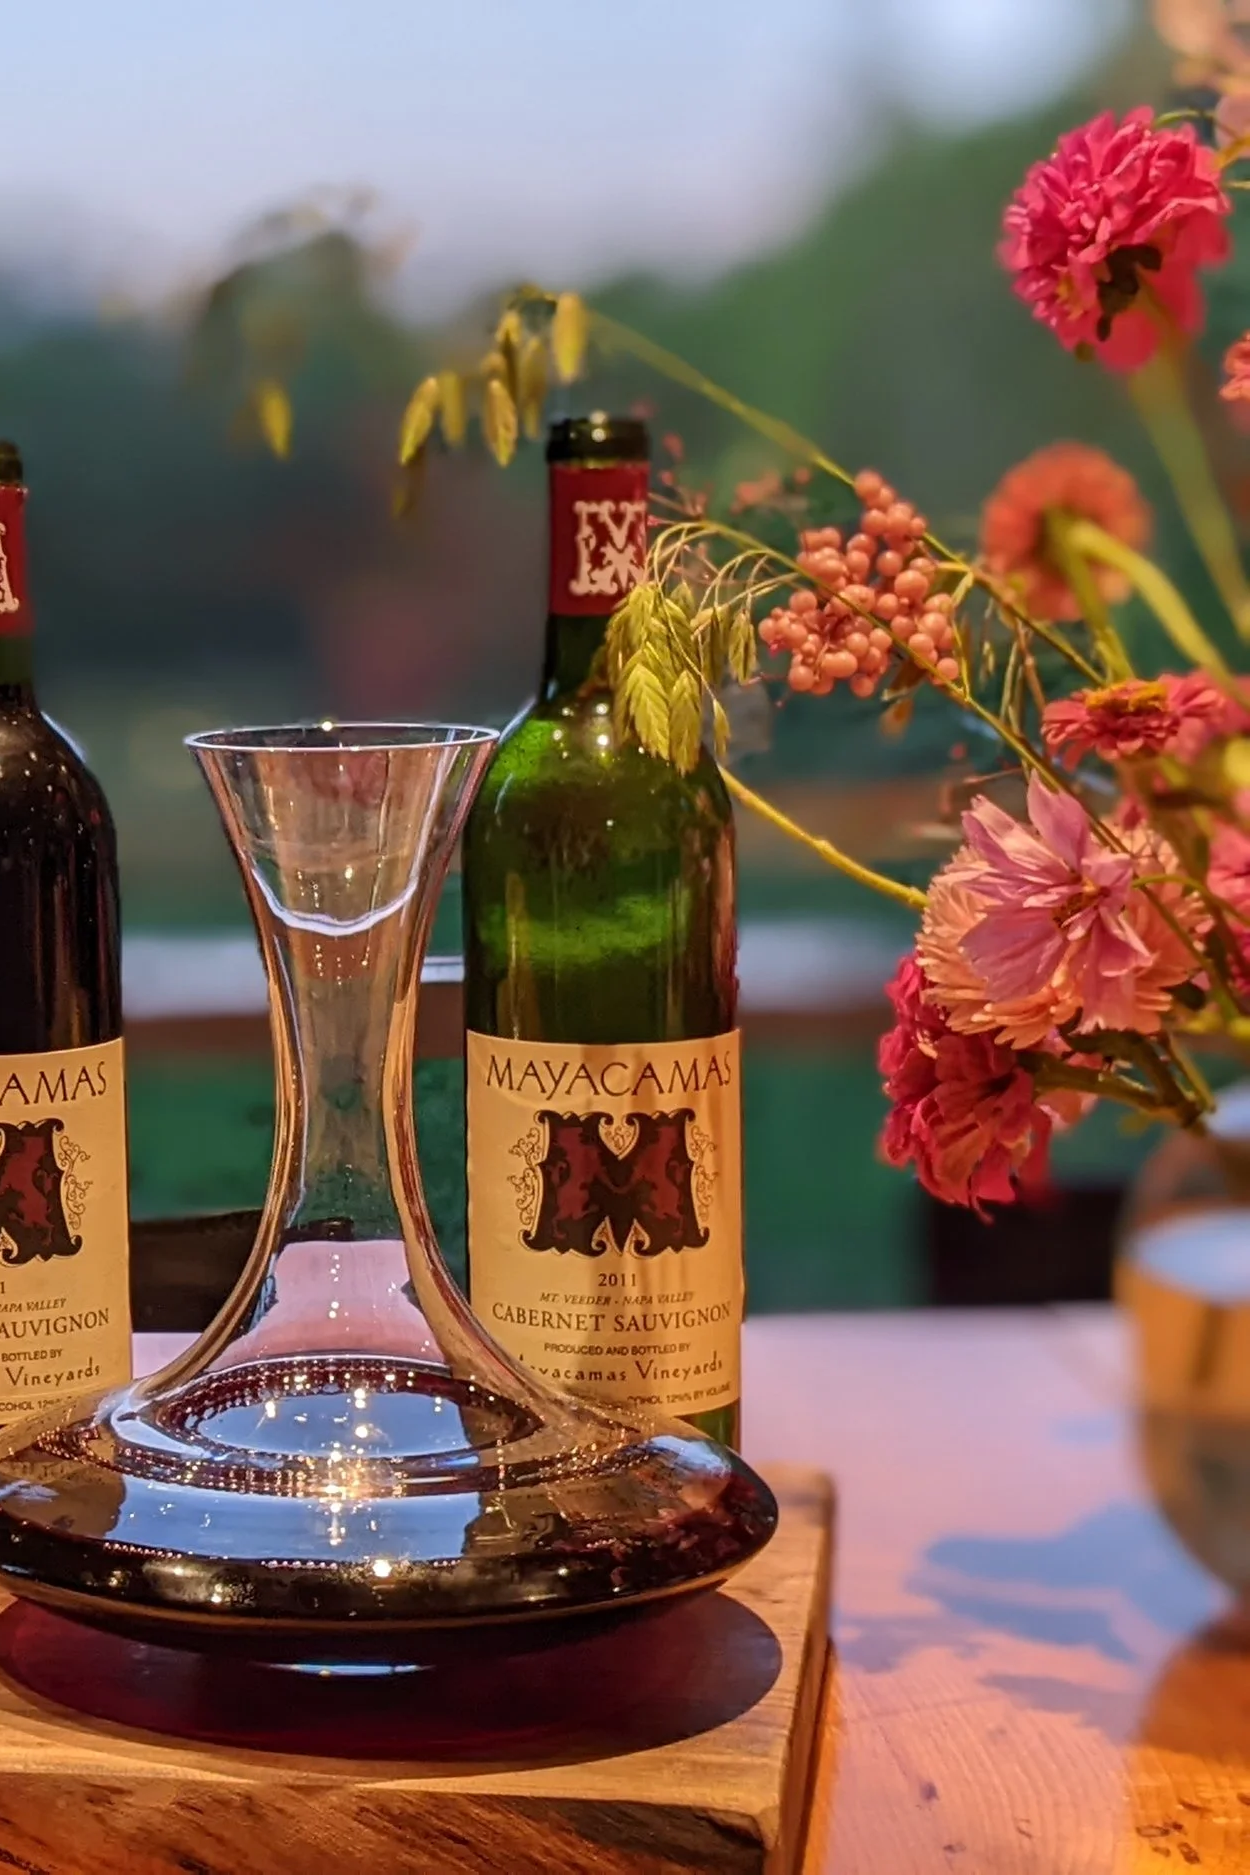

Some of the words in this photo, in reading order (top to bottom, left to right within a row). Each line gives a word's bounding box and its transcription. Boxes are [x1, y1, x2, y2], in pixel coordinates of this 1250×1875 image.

[486, 1050, 732, 1100] MAYACAMAS
[598, 1273, 637, 1287] 2011
[26, 1298, 67, 1311] VALLEY
[564, 1294, 610, 1306] VEEDER
[622, 1296, 653, 1306] NAPA
[492, 1302, 605, 1332] CABERNET
[613, 1301, 732, 1333] SAUVIGNON
[1, 1350, 48, 1363] BOTTLED
[50, 1348, 63, 1359] BY
[544, 1342, 604, 1356] PRODUCED
[605, 1345, 630, 1356] AND
[631, 1344, 677, 1356] BOTTLED
[679, 1342, 692, 1352] BY
[5, 1357, 100, 1387] Vineyards
[634, 1351, 723, 1381] Vineyards
[693, 1390, 704, 1401] BY
